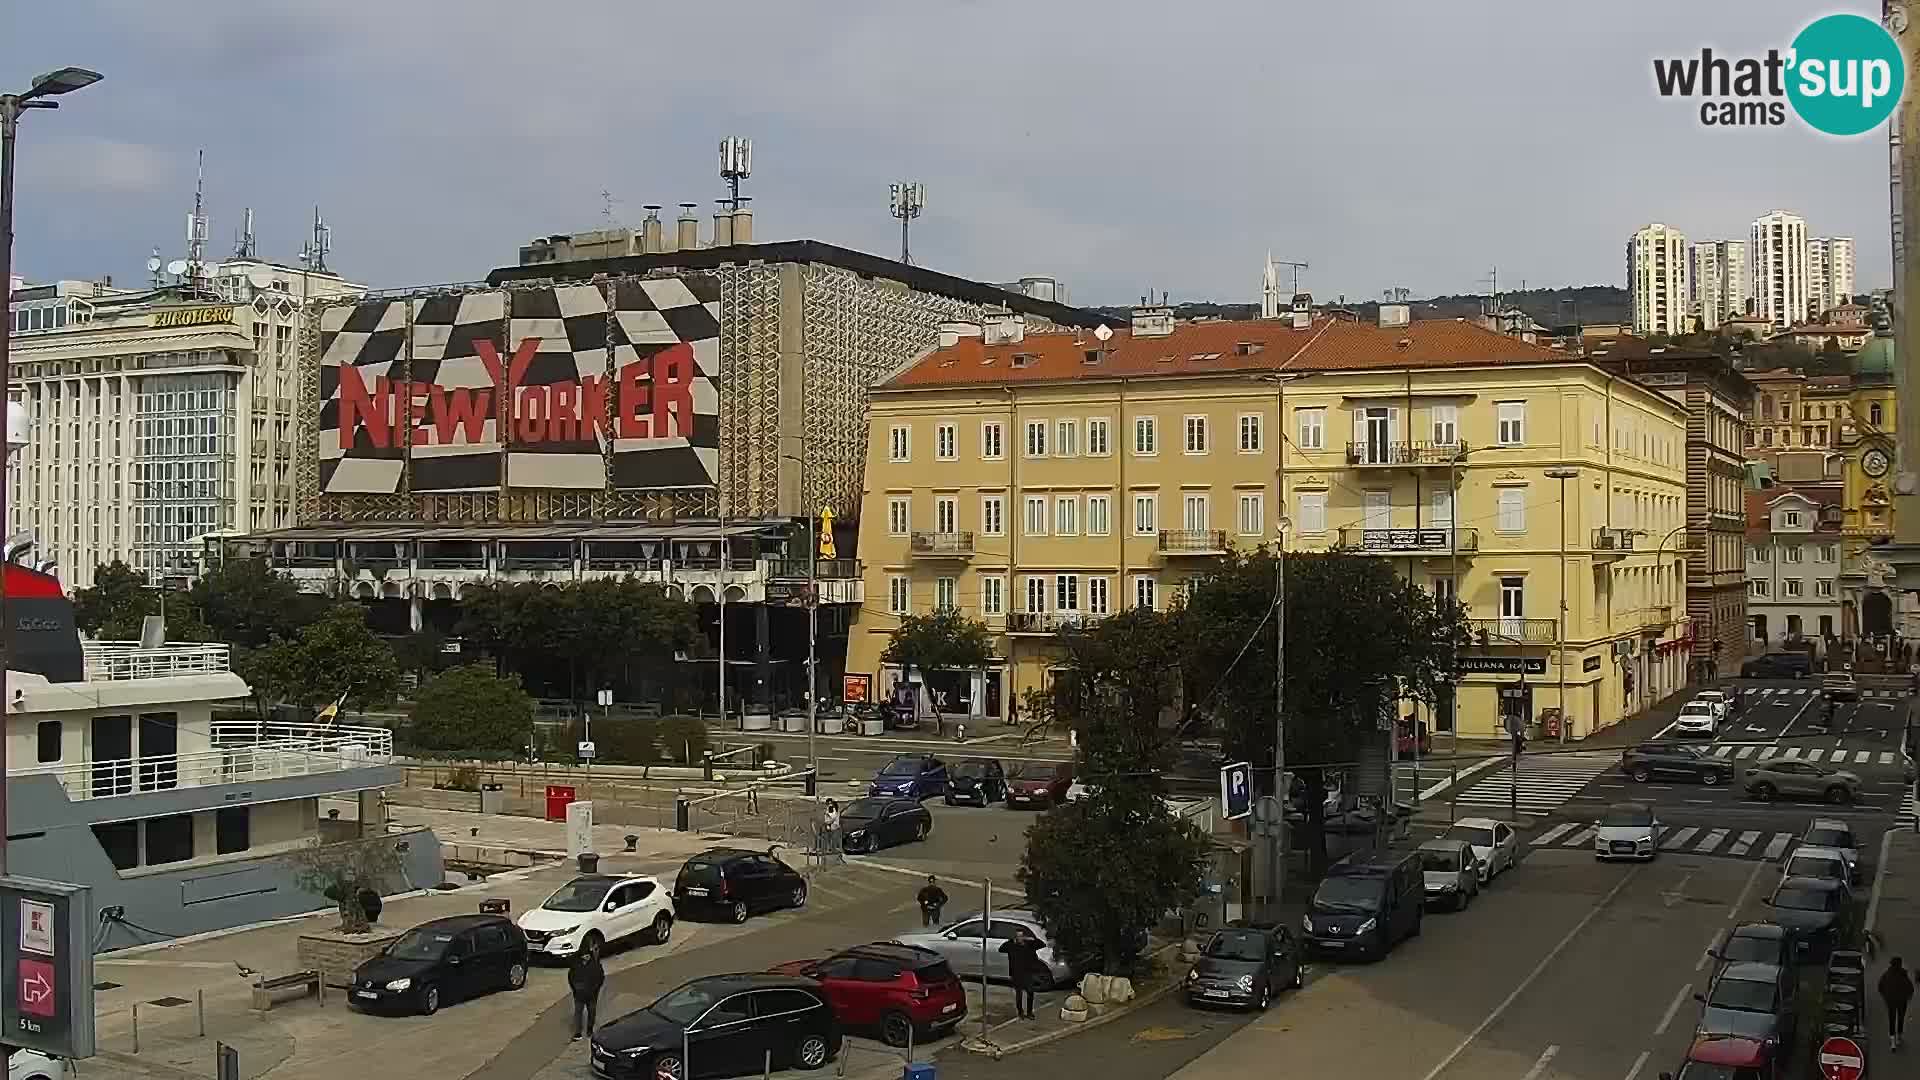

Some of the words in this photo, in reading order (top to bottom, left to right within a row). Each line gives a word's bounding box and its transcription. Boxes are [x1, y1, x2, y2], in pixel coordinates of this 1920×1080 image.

[1460, 661, 1505, 670] JULIANA
[20, 1018, 26, 1030] 5
[27, 1019, 41, 1033] km
